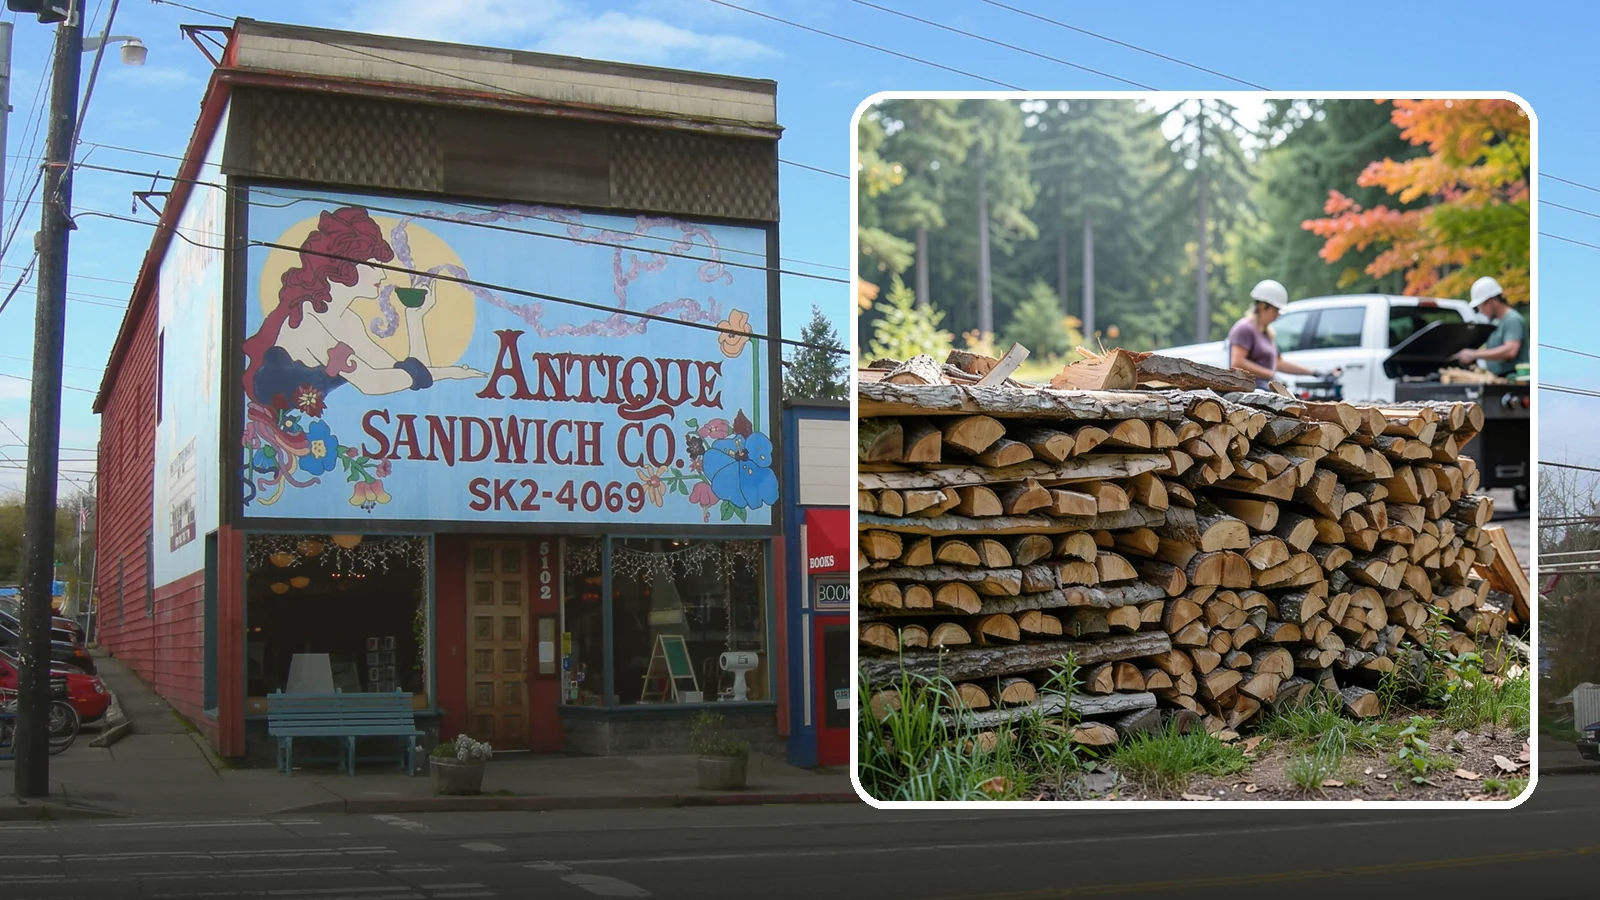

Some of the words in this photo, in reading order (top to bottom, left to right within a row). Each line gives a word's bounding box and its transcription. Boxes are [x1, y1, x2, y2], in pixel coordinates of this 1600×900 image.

[475, 329, 723, 420] ANTIQUE
[361, 408, 604, 467] SANDWICH
[617, 421, 685, 469] CO.
[468, 476, 646, 513] SK2-4069
[539, 541, 552, 600] 5102
[809, 555, 835, 569] BOOKS
